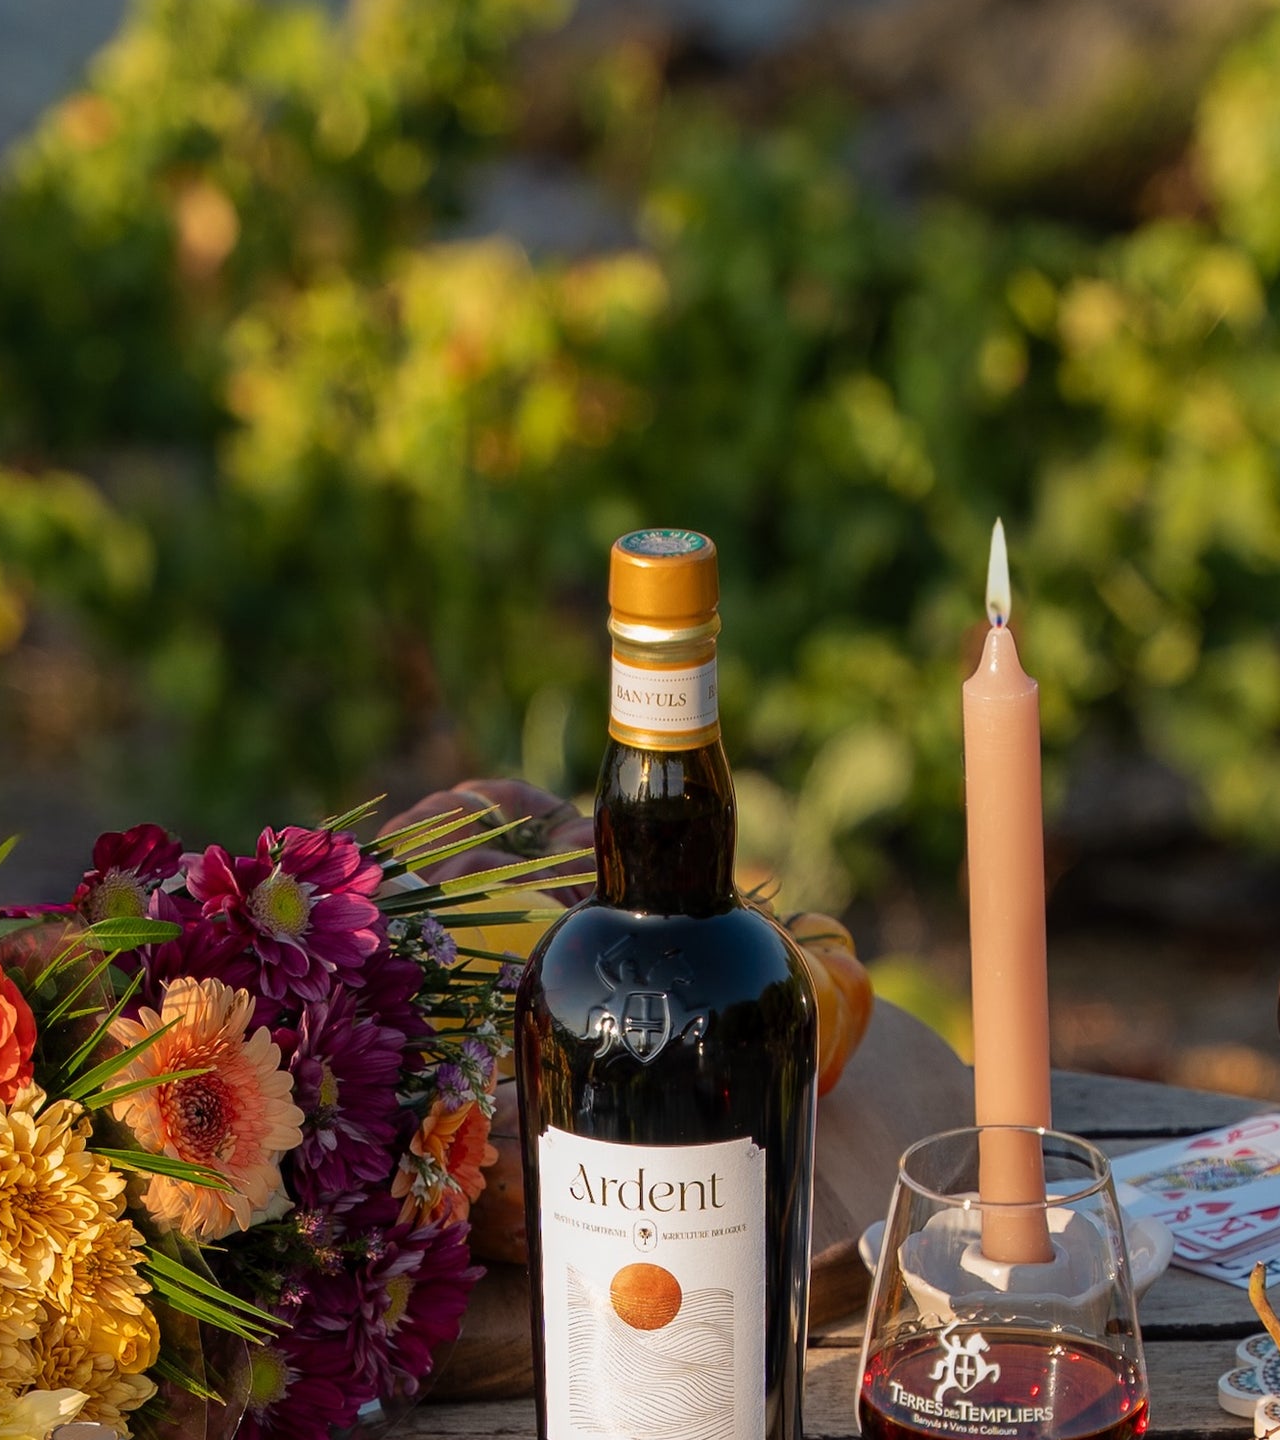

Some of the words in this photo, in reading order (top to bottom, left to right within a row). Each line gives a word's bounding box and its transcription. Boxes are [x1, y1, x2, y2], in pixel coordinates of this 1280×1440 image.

[616, 684, 687, 707] BANYULS
[569, 1163, 726, 1212] Ardent
[662, 1231, 710, 1241] AGRICULTURE
[1193, 1217, 1257, 1242] K
[889, 1381, 944, 1417] TERRES
[955, 1400, 1054, 1423] TEMPLIERS
[913, 1413, 942, 1429] Banyuls
[949, 1422, 968, 1433] Vins
[969, 1424, 979, 1434] de
[980, 1426, 1018, 1436] Collioure
